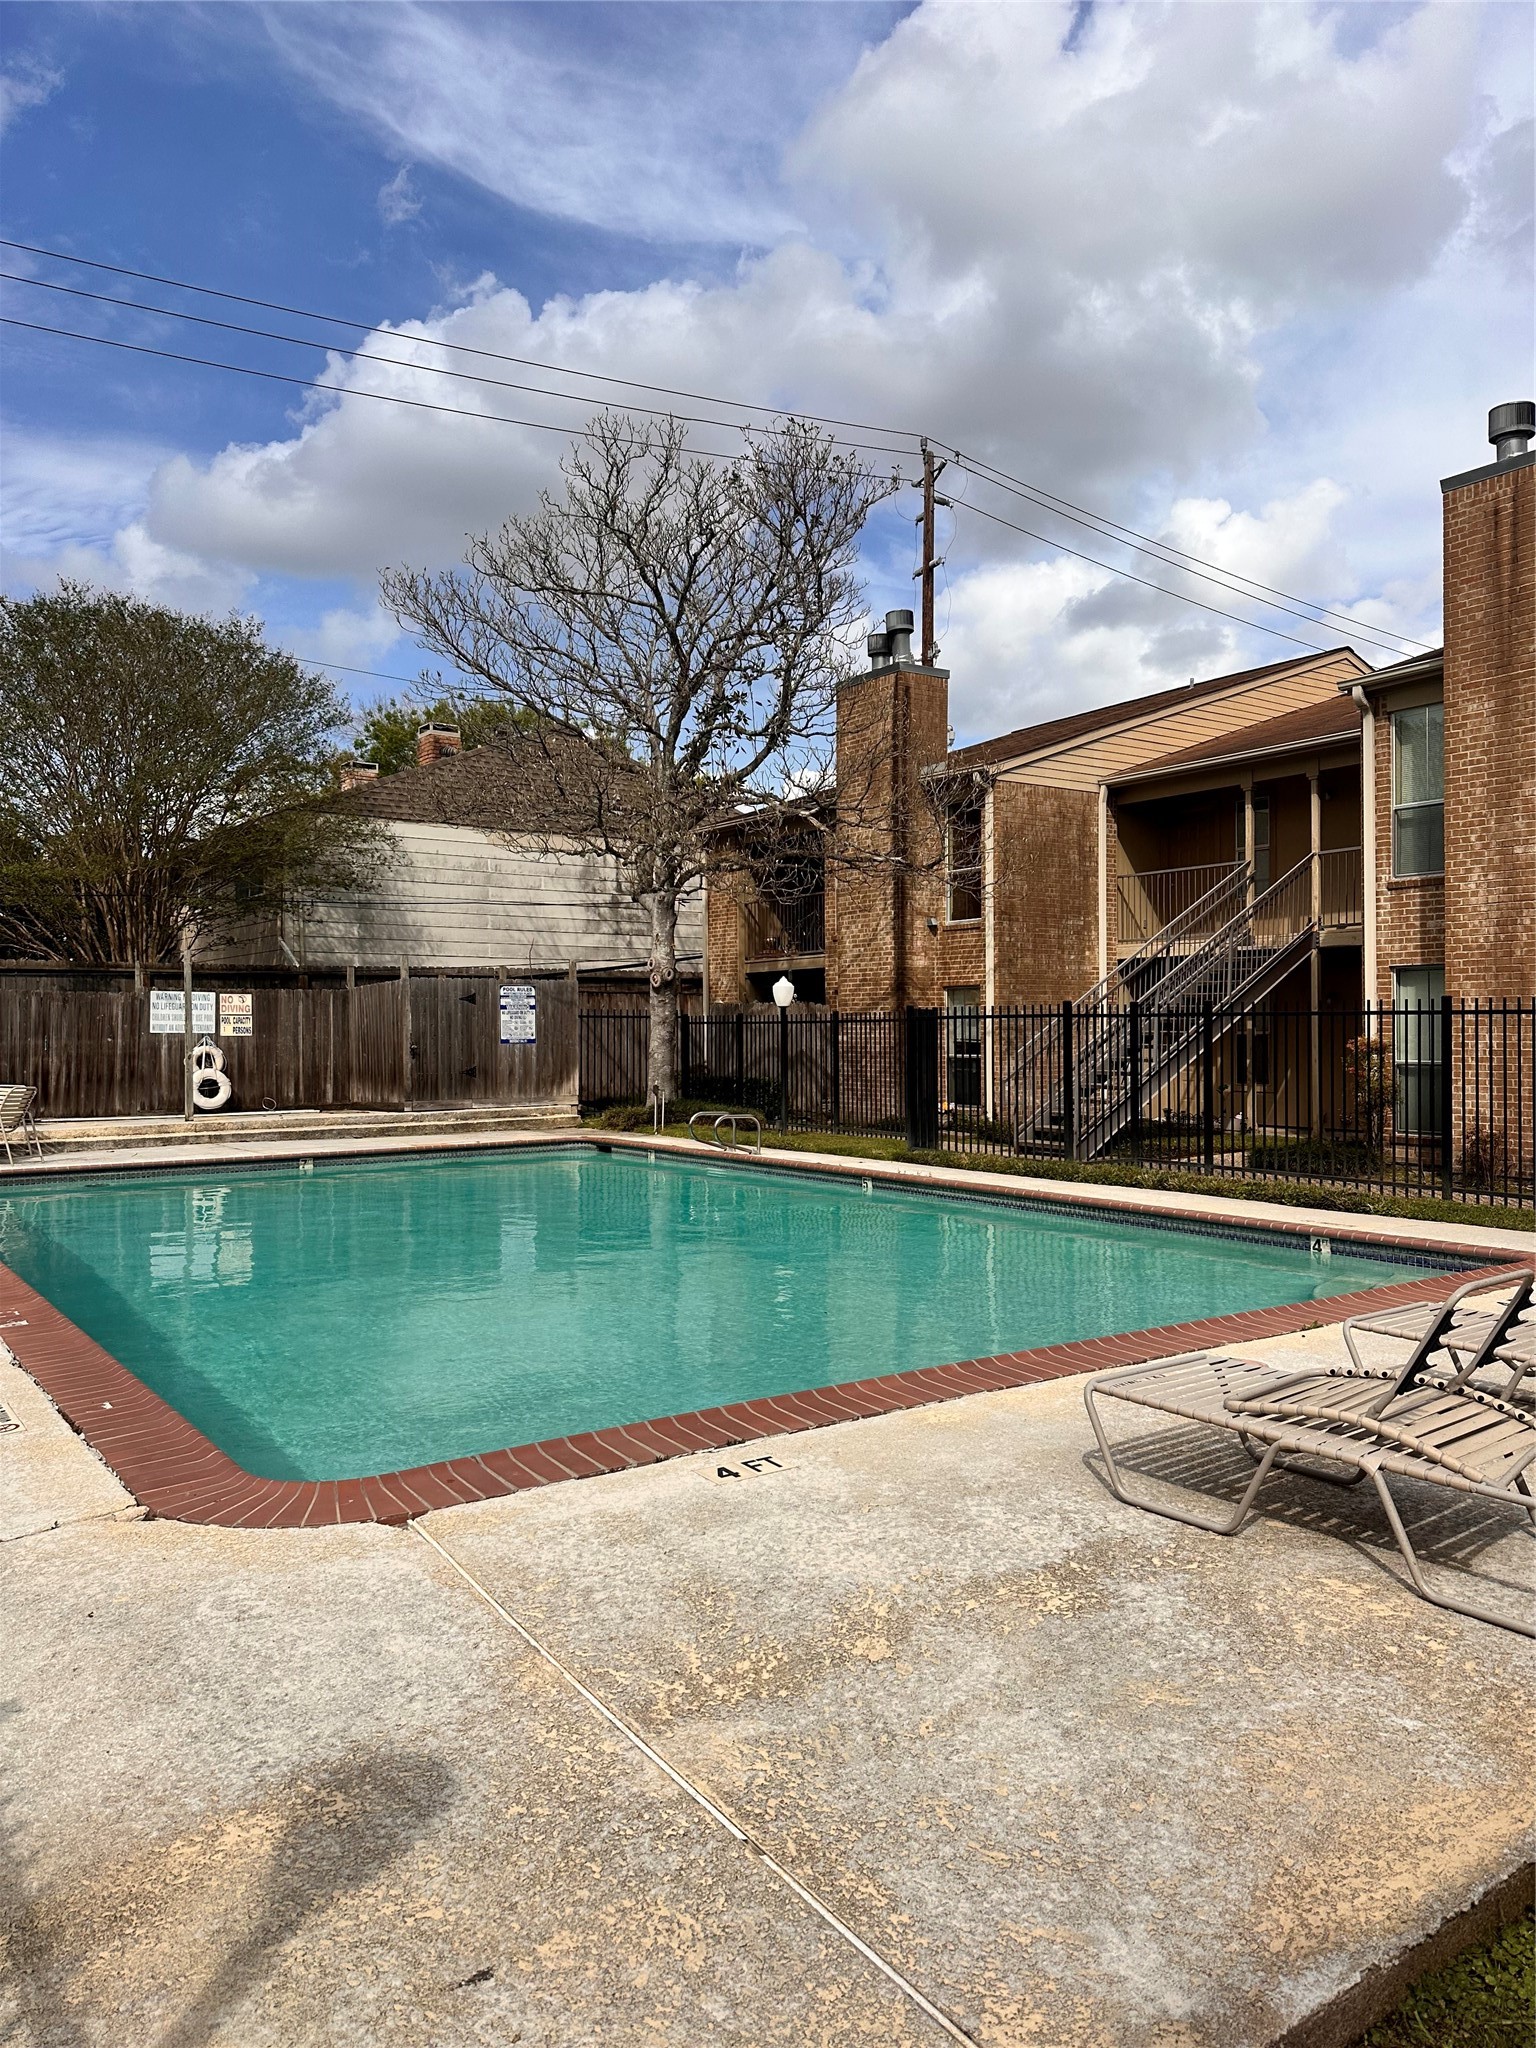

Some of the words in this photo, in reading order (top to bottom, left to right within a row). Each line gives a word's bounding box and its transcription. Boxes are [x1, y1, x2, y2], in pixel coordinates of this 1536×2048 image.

[156, 993, 181, 1001] WARNING
[192, 994, 211, 1002] DIVING
[221, 995, 234, 1004] NO
[152, 1002, 159, 1010] NO
[160, 1002, 186, 1011] LIFEGUAR
[199, 1003, 214, 1011] DUTY
[221, 1004, 251, 1013] DIVING
[151, 1013, 171, 1021] CHILDREN
[221, 1017, 232, 1025] POOL
[232, 1017, 251, 1025] CAPACITY
[232, 1026, 252, 1034] PERSONS
[1312, 1238, 1322, 1252] 4
[717, 1466, 741, 1478] 4
[740, 1455, 783, 1472] FT
